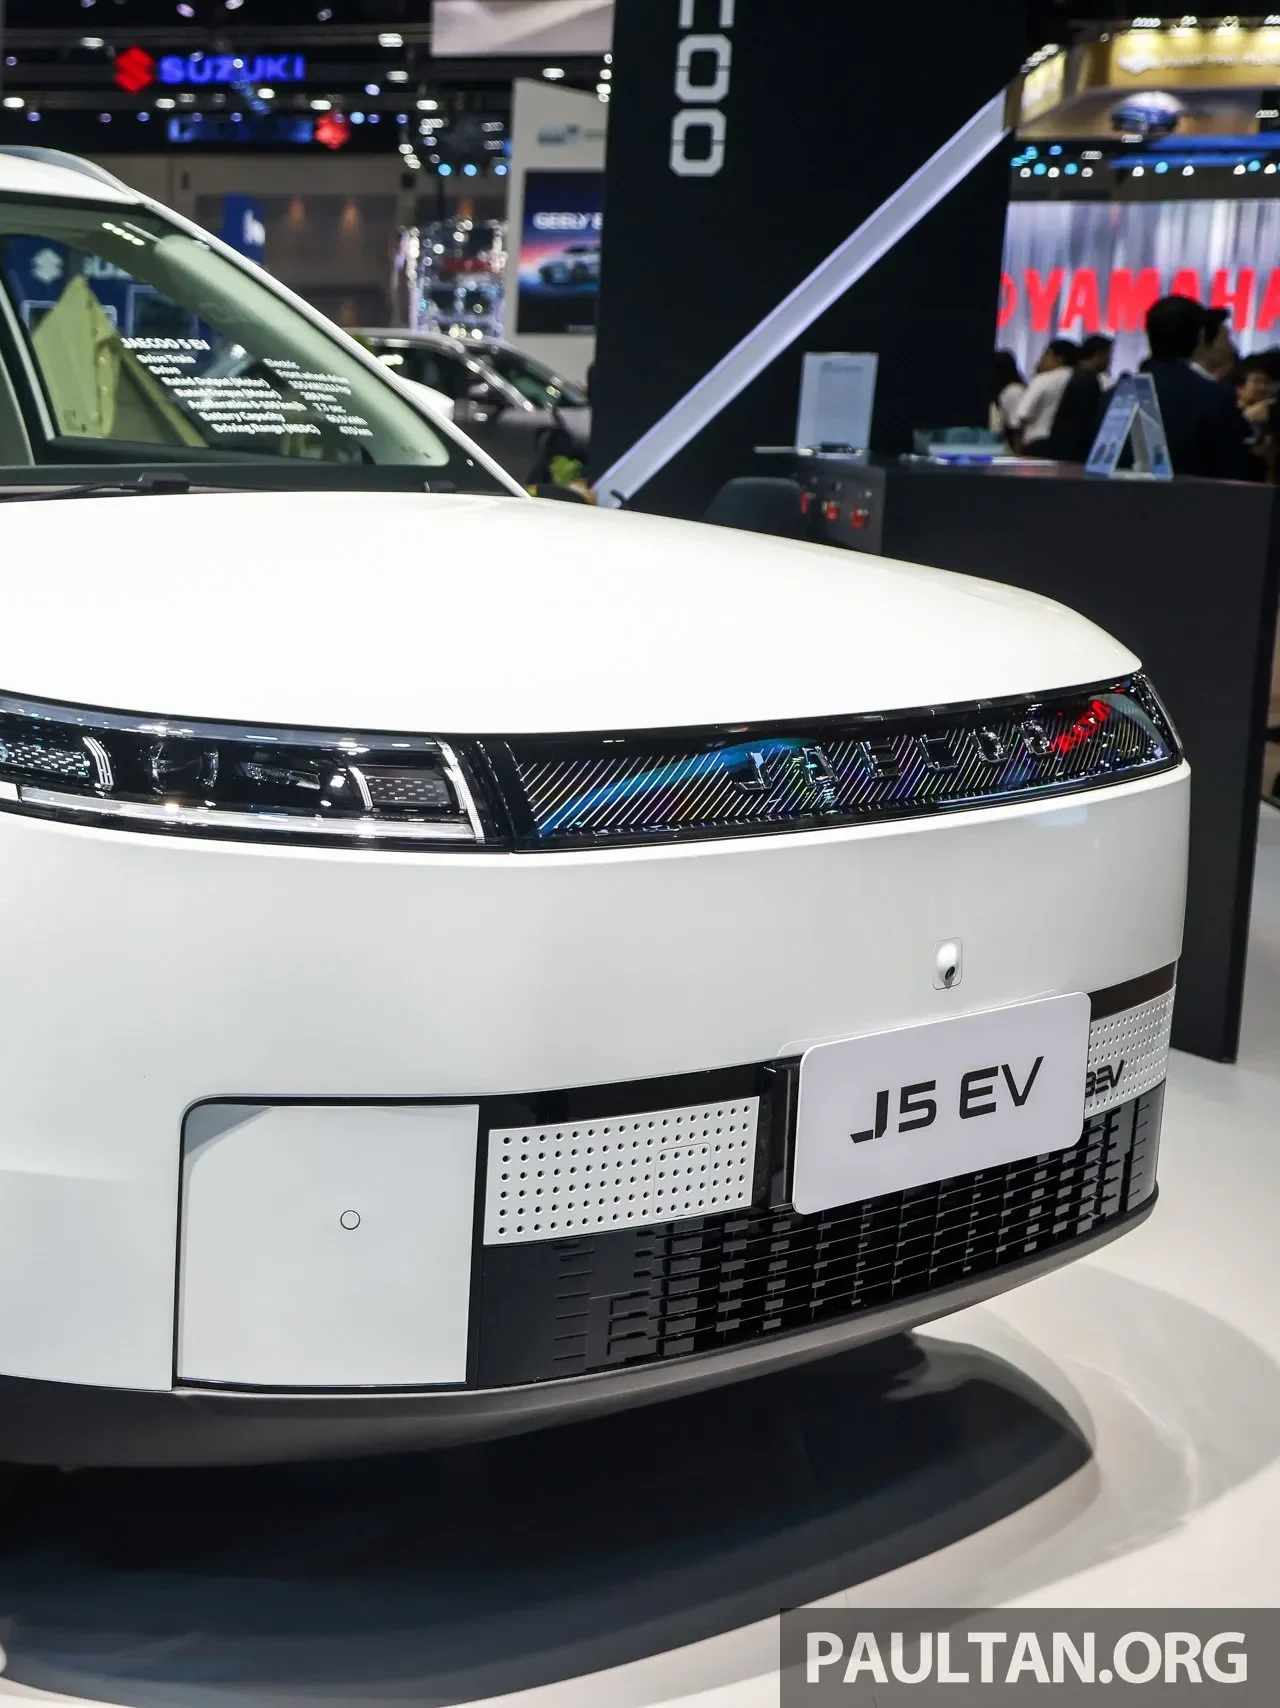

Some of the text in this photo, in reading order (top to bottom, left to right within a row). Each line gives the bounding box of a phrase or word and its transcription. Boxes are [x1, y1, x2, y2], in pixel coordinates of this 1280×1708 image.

[158, 53, 306, 85] SUZUKI
[120, 337, 180, 349] JAECOO
[732, 718, 1054, 791] JAECOO
[850, 1055, 1044, 1144] J5 EV
